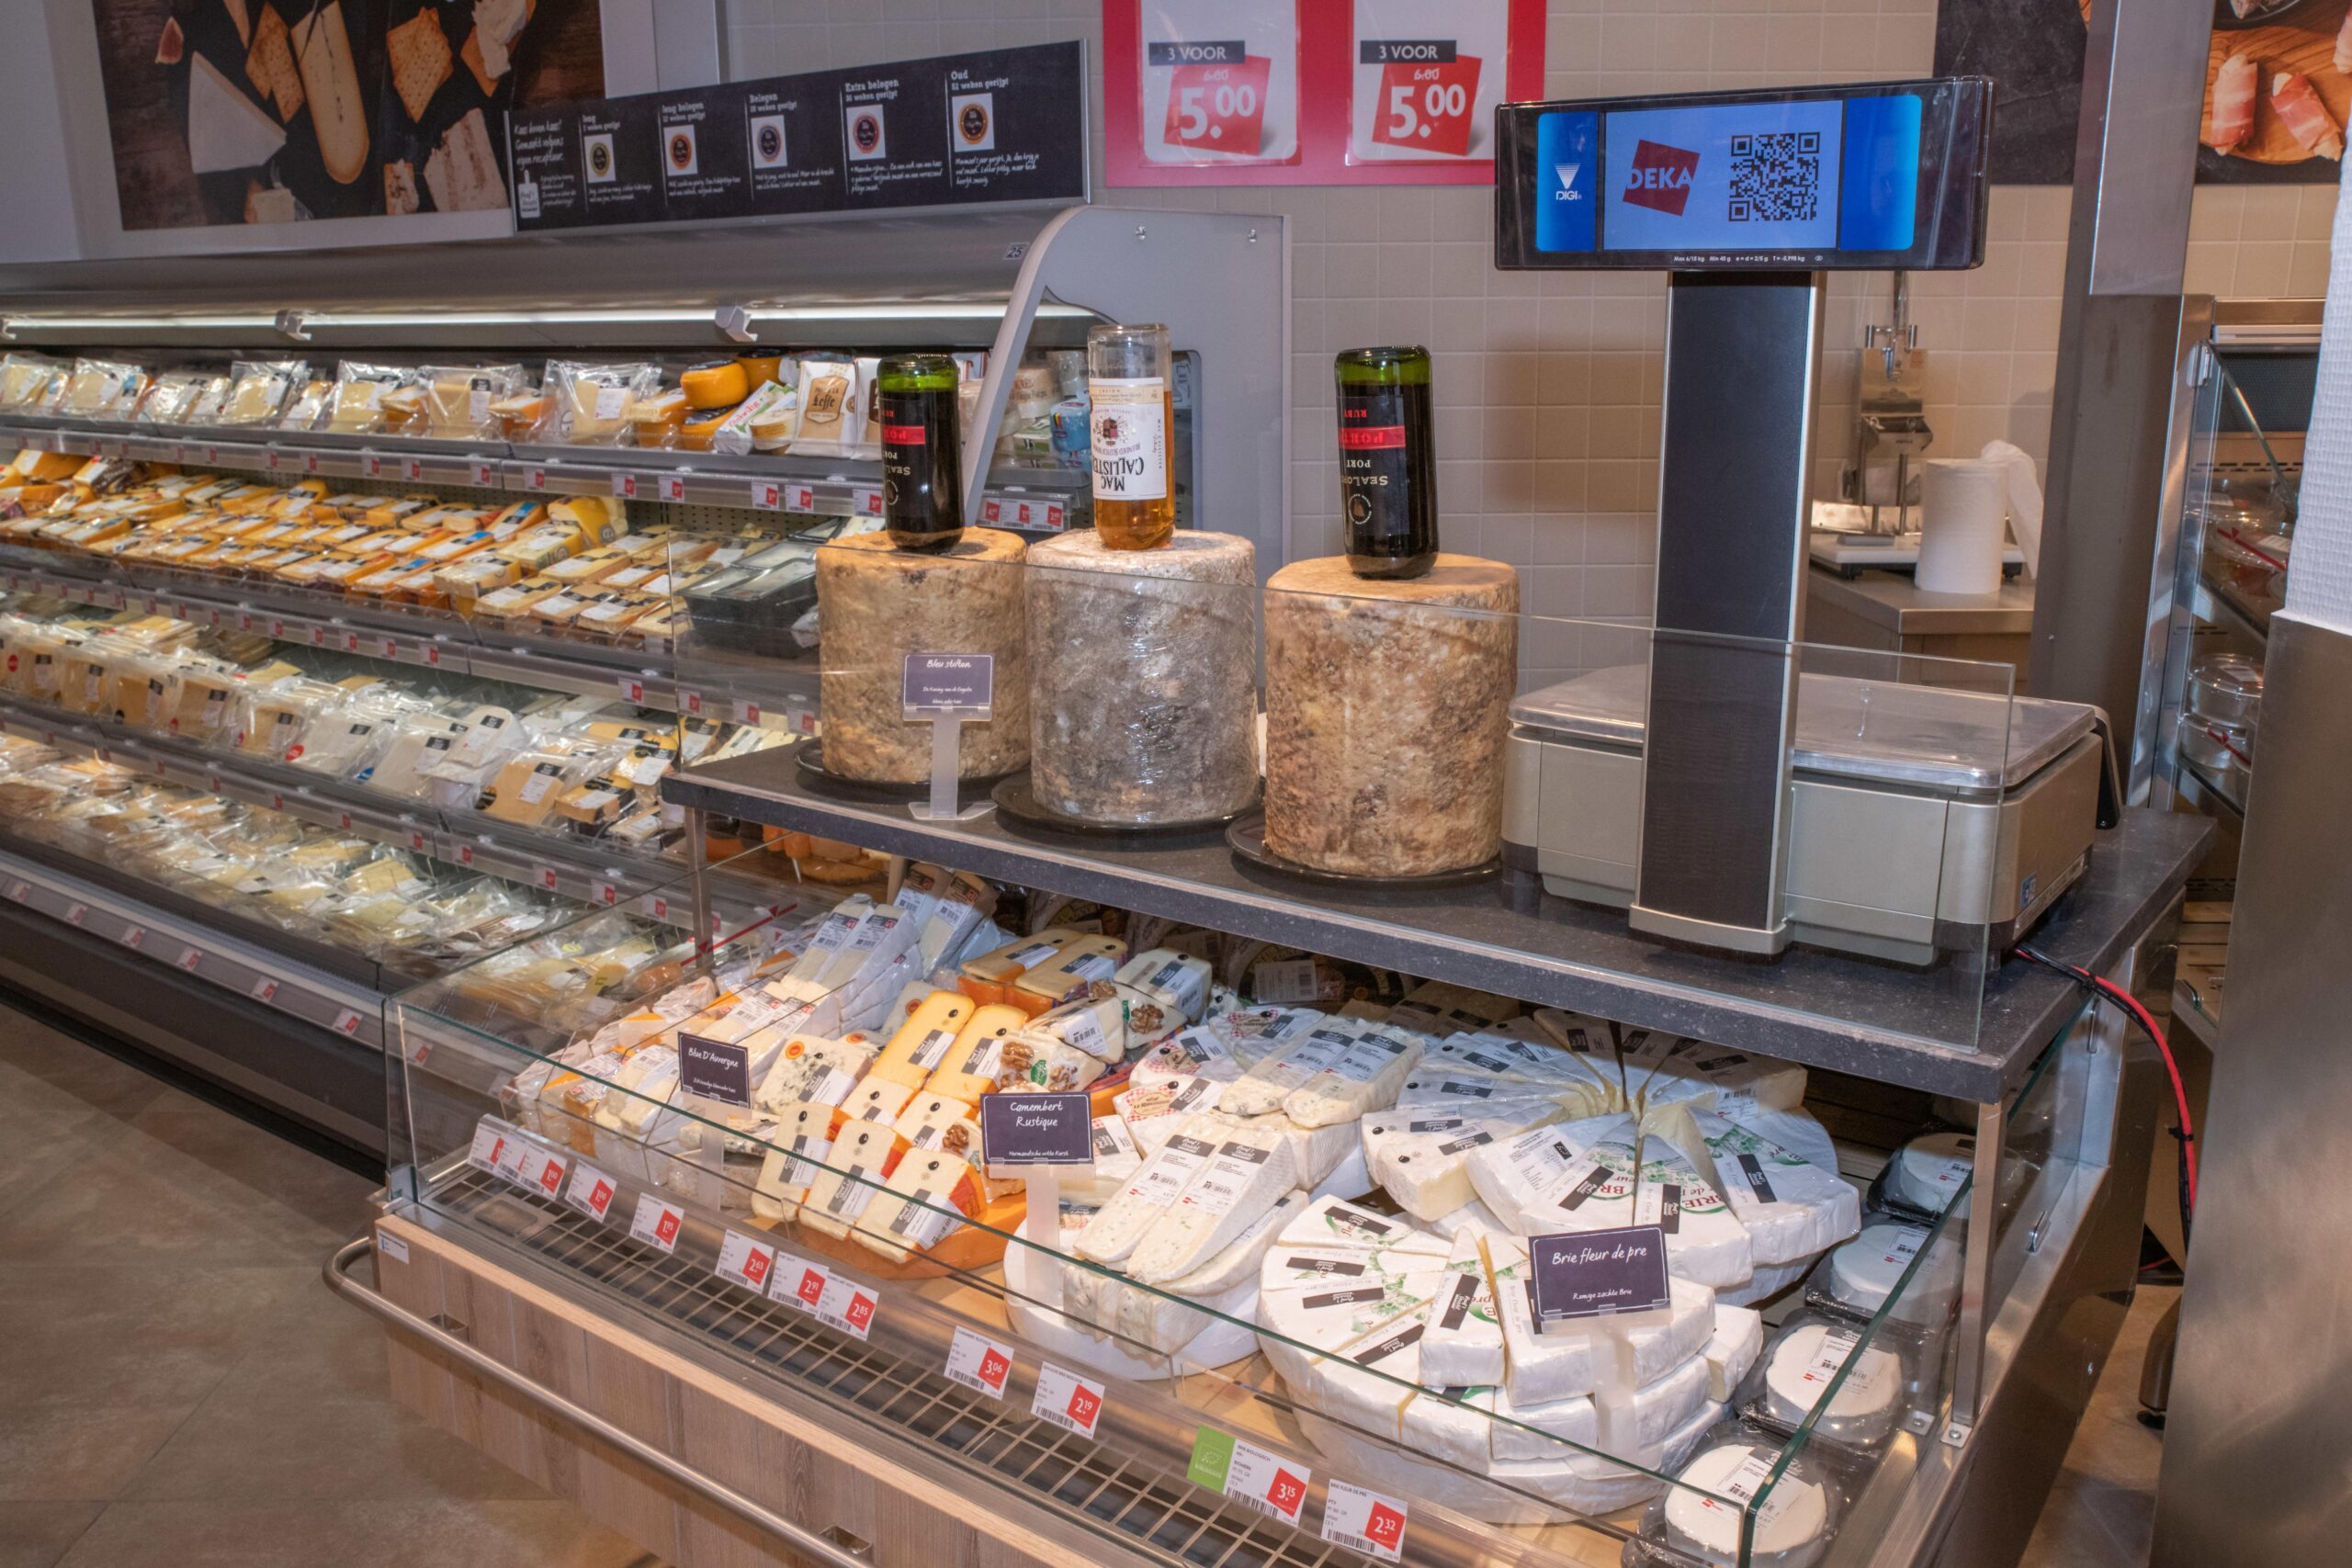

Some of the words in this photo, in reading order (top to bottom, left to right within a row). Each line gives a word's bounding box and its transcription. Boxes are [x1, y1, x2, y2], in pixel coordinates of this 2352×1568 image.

[1168, 48, 1175, 61] 3
[1179, 47, 1227, 61] VOOR
[1379, 47, 1386, 60] 3
[1390, 46, 1438, 60] VOOR
[951, 69, 968, 81] Oud
[845, 81, 866, 93] Extra
[868, 79, 899, 91] belegen
[961, 81, 982, 90] weken
[985, 77, 1009, 89] gerijpt
[749, 93, 778, 103] Belegen
[1180, 85, 1256, 140] 5.00
[1389, 85, 1465, 139] 5.00
[1628, 166, 1693, 189] DEKA
[1555, 190, 1578, 201] DIGI
[1346, 458, 1371, 468] PORT
[1101, 476, 1125, 491] MAC
[926, 659, 944, 669] Bleu
[702, 1050, 739, 1070] D'Auvergne
[1010, 1100, 1063, 1111] Camembert
[1015, 1115, 1058, 1131] Rustique
[1552, 1251, 1577, 1265] Brie
[1578, 1247, 1610, 1265] fleur
[1611, 1243, 1625, 1259] de
[1625, 1246, 1647, 1264] pre
[1074, 1396, 1093, 1416] 2.19
[1277, 1482, 1296, 1502] 3.15
[1374, 1515, 1396, 1536] 2.32
